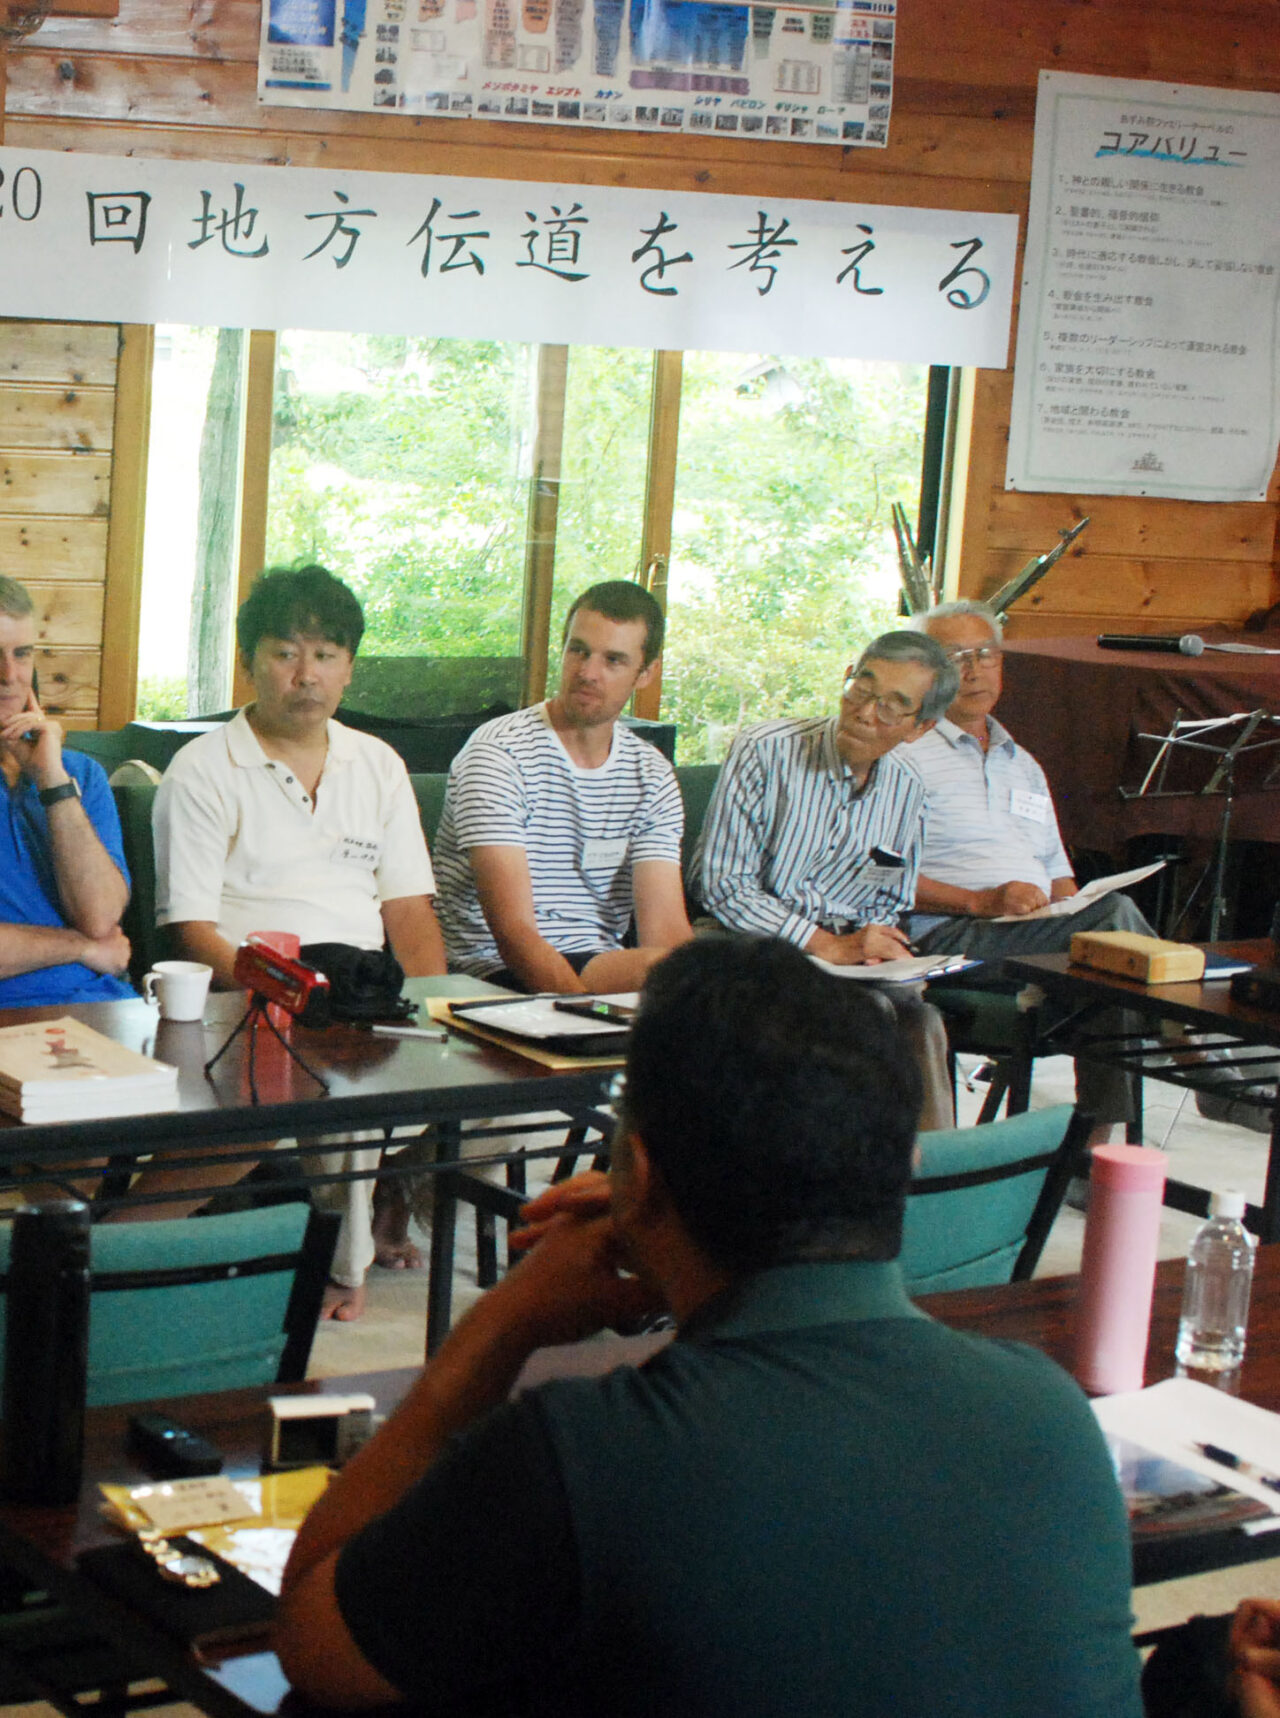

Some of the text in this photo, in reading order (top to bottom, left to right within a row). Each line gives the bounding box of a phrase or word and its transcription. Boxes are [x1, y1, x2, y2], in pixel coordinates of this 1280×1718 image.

[1099, 130, 1248, 161] コアバリュー
